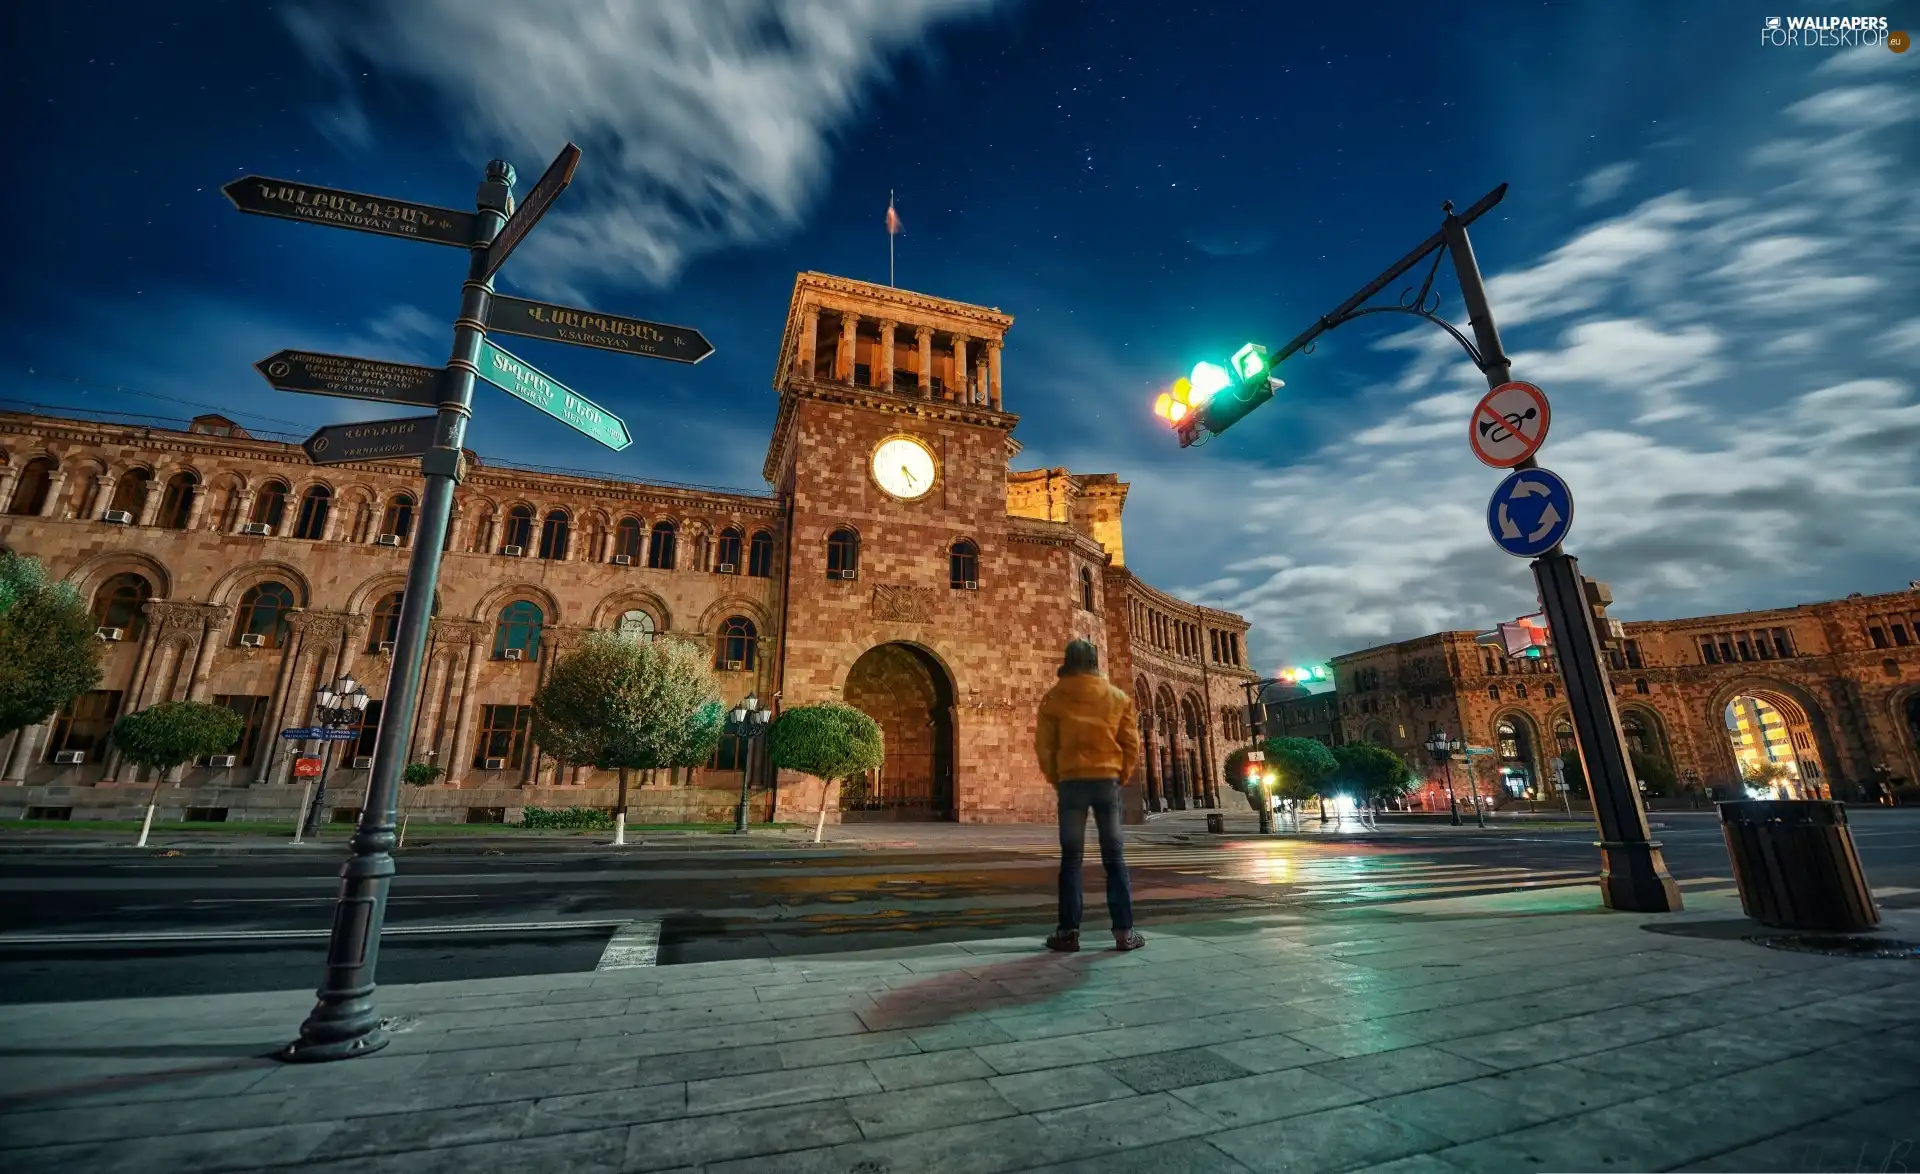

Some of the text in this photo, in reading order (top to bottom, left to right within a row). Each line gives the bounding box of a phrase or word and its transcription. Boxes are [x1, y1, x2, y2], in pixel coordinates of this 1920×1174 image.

[295, 206, 392, 229] NALBANDYAN
[309, 372, 349, 383] MUSEUM
[492, 353, 554, 399] ՏԻԳՐԱՆ
[564, 393, 602, 425] ՄԵԾԻ
[343, 384, 385, 395] ARMENIA
[513, 381, 549, 407] TIGRAN
[562, 409, 585, 427] METS
